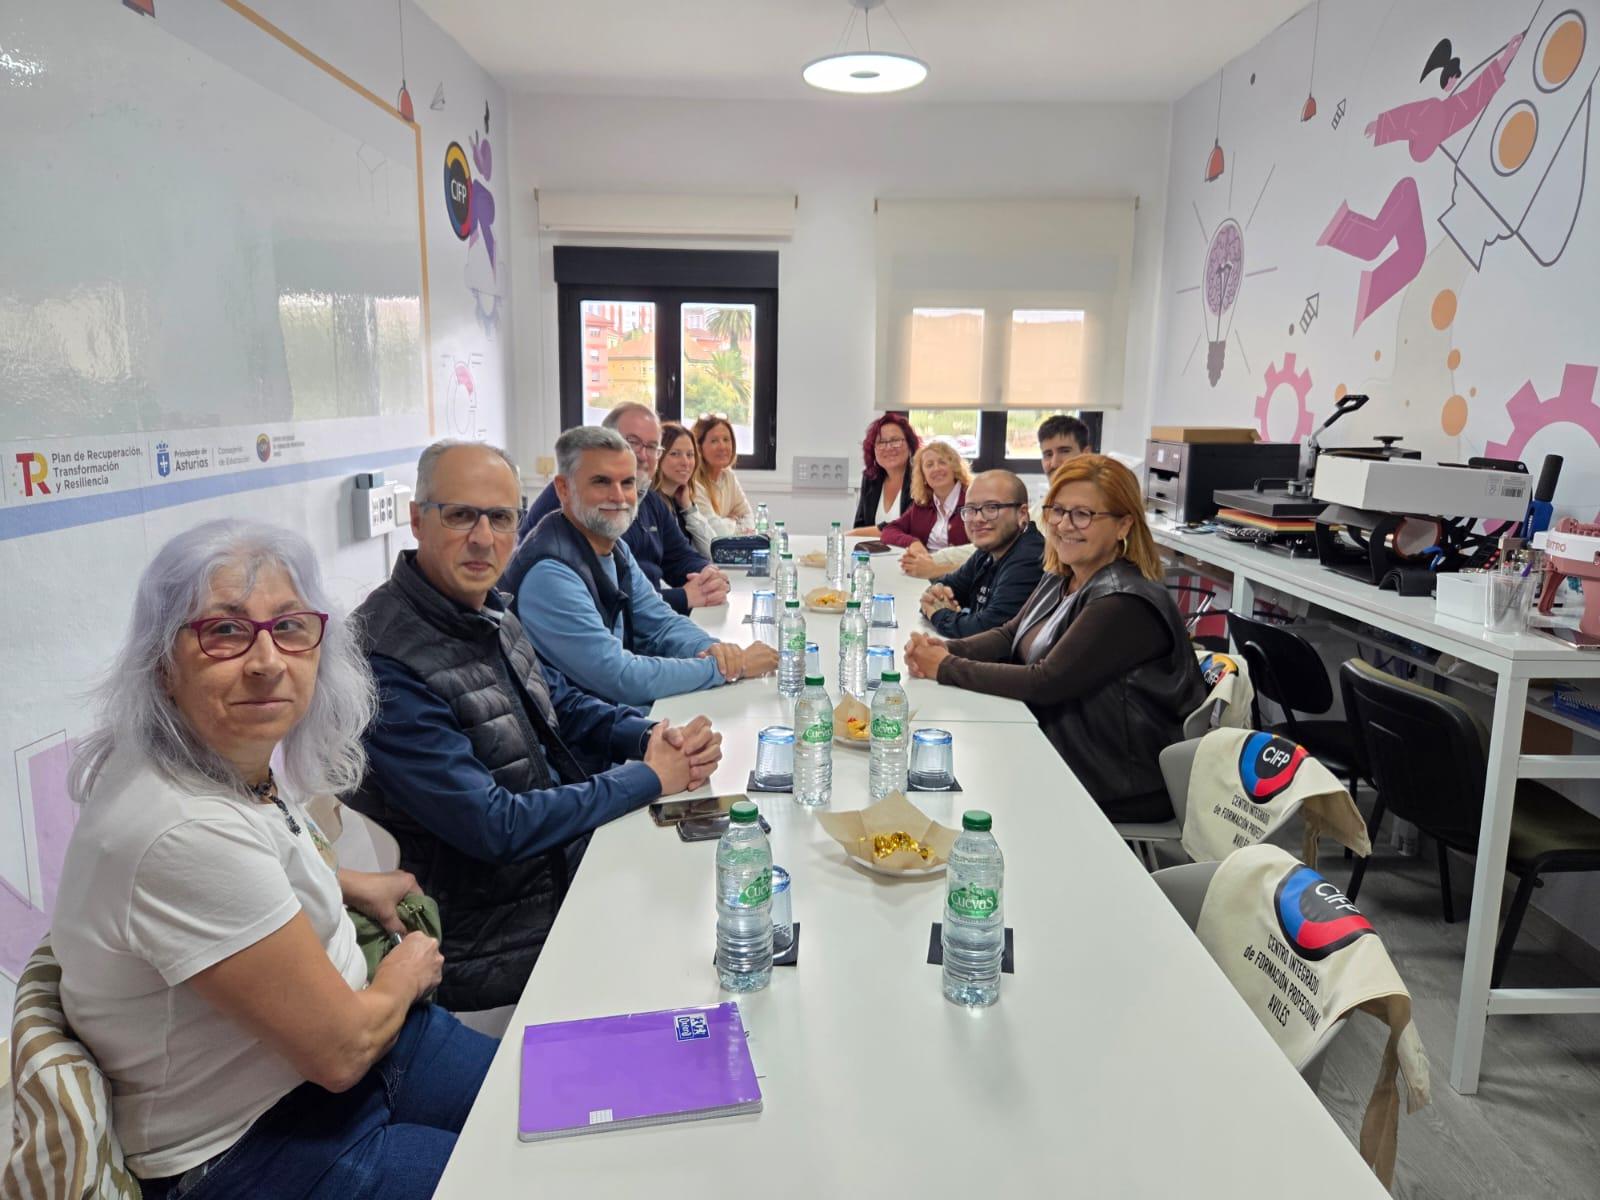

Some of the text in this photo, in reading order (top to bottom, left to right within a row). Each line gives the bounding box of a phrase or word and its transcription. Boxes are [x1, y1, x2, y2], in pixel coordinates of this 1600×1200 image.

[451, 179, 467, 204] CIFP
[51, 452, 71, 463] Plan
[74, 451, 85, 461] de
[175, 457, 209, 472] Asturias
[52, 461, 120, 478] Transformación
[56, 475, 109, 493] y Resiliencia
[1262, 747, 1291, 768] CIFP
[1231, 794, 1249, 813] CENTRO
[1213, 804, 1222, 815] de
[1221, 807, 1249, 831] FORMACIÓN
[1315, 882, 1361, 914] CIFP
[1243, 945, 1256, 961] de
[1254, 951, 1290, 994] FORMACIÓN
[1268, 934, 1320, 996] CENTRO INTEGRADO
[1267, 993, 1290, 1027] AVILÉS
